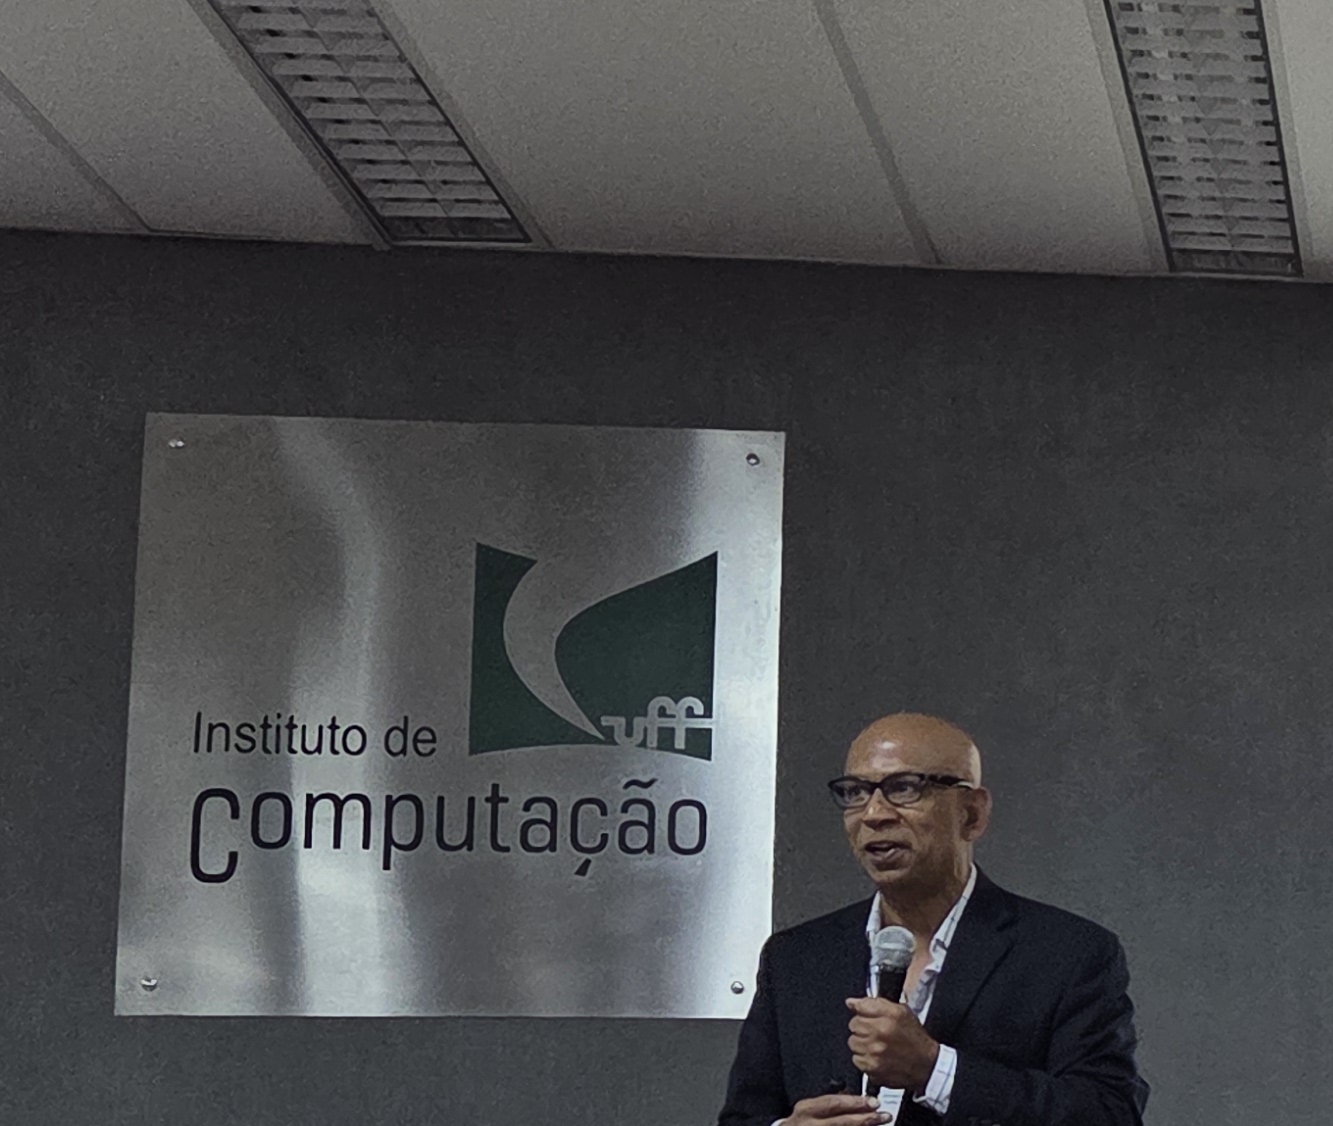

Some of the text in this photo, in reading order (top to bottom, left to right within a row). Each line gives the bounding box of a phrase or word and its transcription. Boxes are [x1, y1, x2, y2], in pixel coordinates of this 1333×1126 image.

[192, 711, 437, 758] Instituto de
[601, 695, 714, 751] uff
[190, 777, 708, 884] Computação
